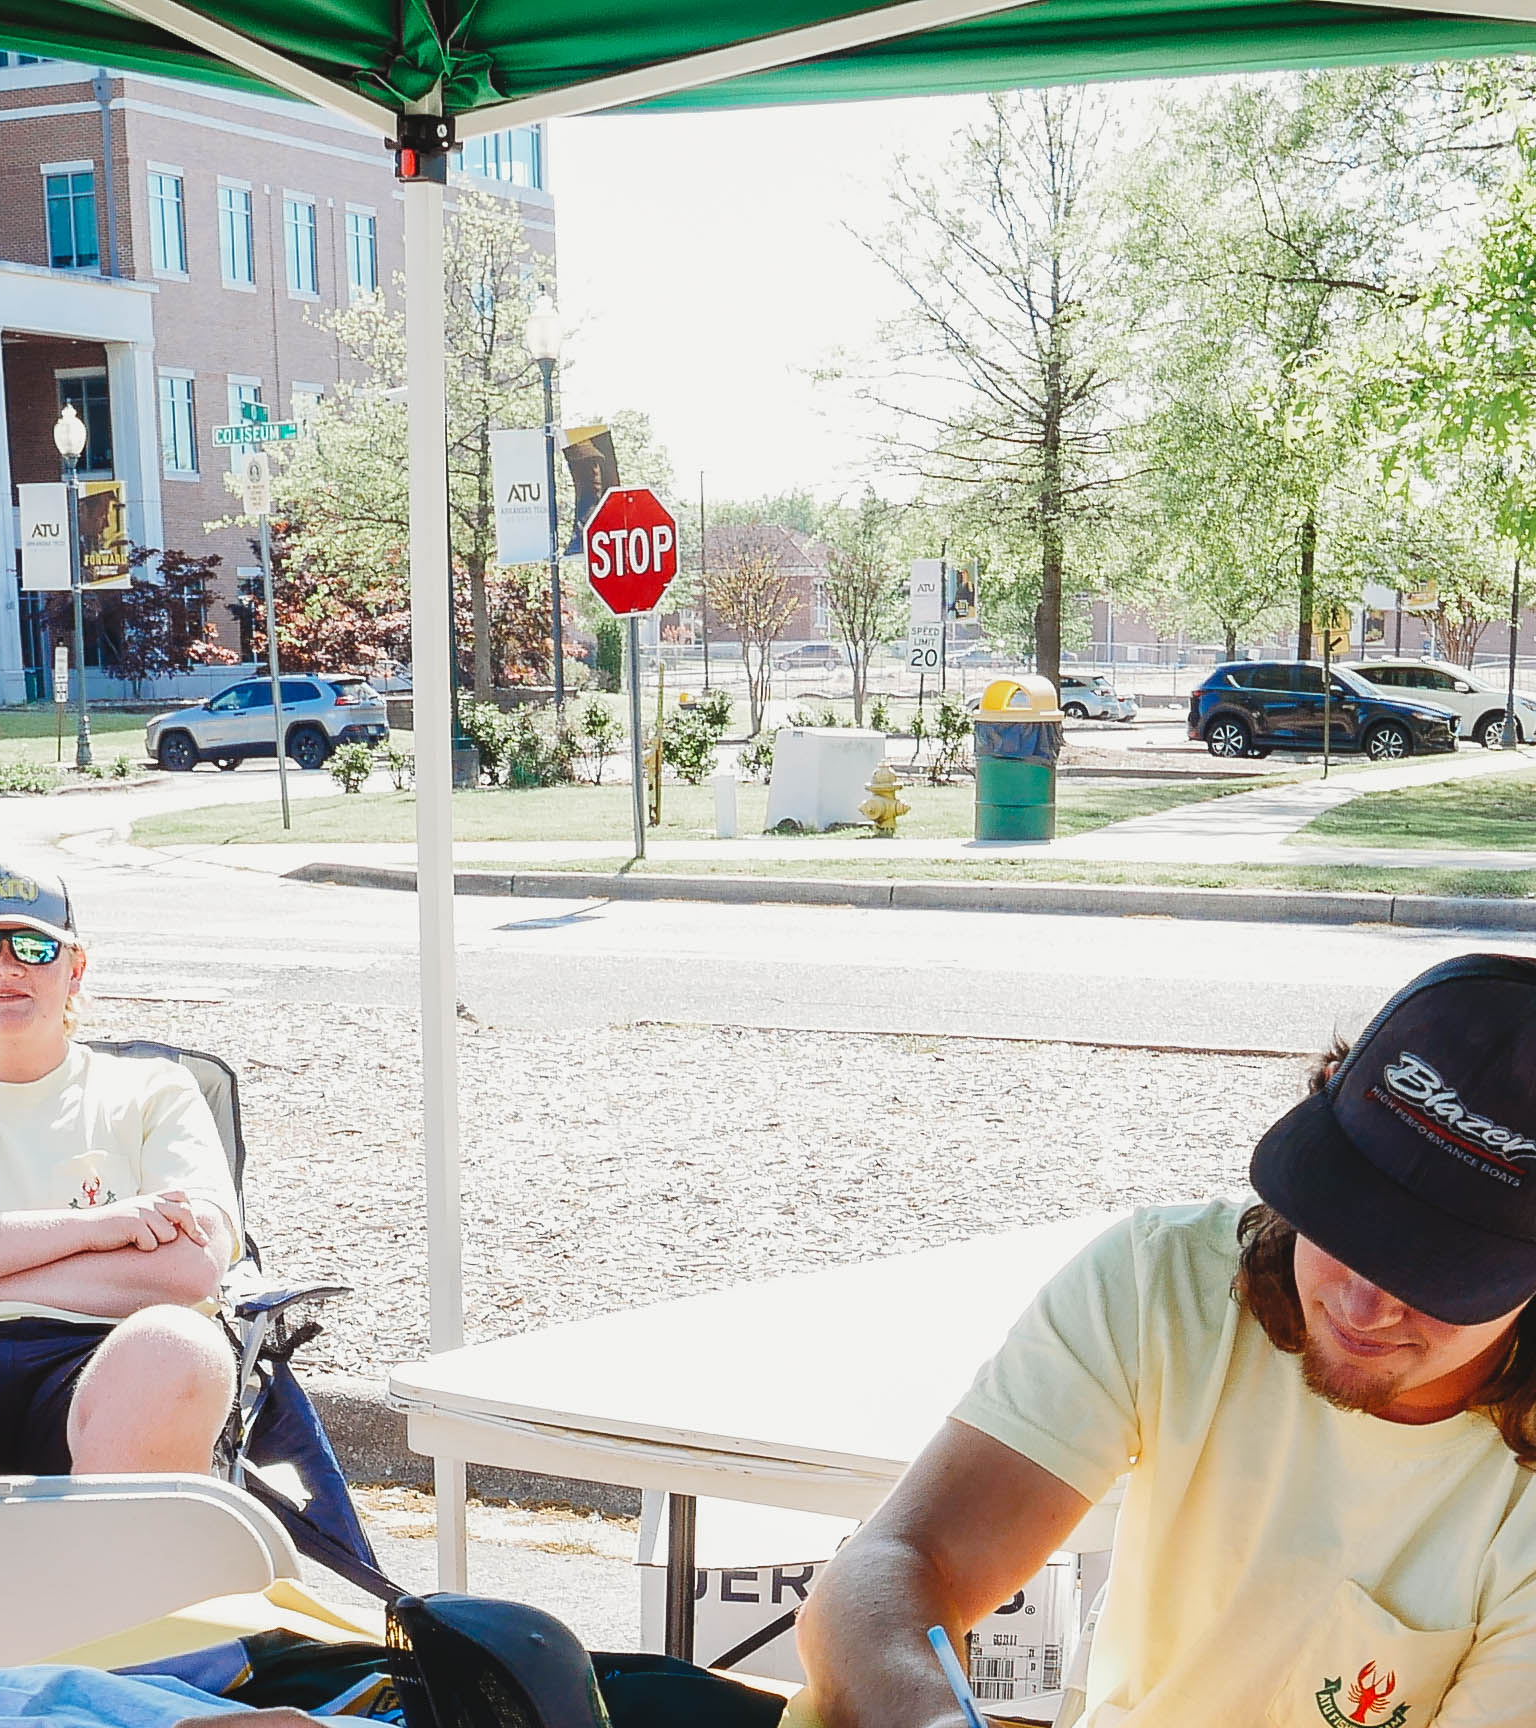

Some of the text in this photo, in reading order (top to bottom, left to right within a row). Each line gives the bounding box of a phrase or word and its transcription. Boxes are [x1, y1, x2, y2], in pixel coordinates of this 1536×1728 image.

[215, 424, 279, 444] COLISEUM
[507, 483, 541, 503] ATU
[32, 523, 59, 538] ATU
[591, 525, 673, 578] STOP
[917, 584, 935, 592] ATU
[911, 627, 939, 636] SPEED
[911, 649, 937, 667] 20
[1371, 1085, 1521, 1188] HIGH PERFORMANCE BOATS
